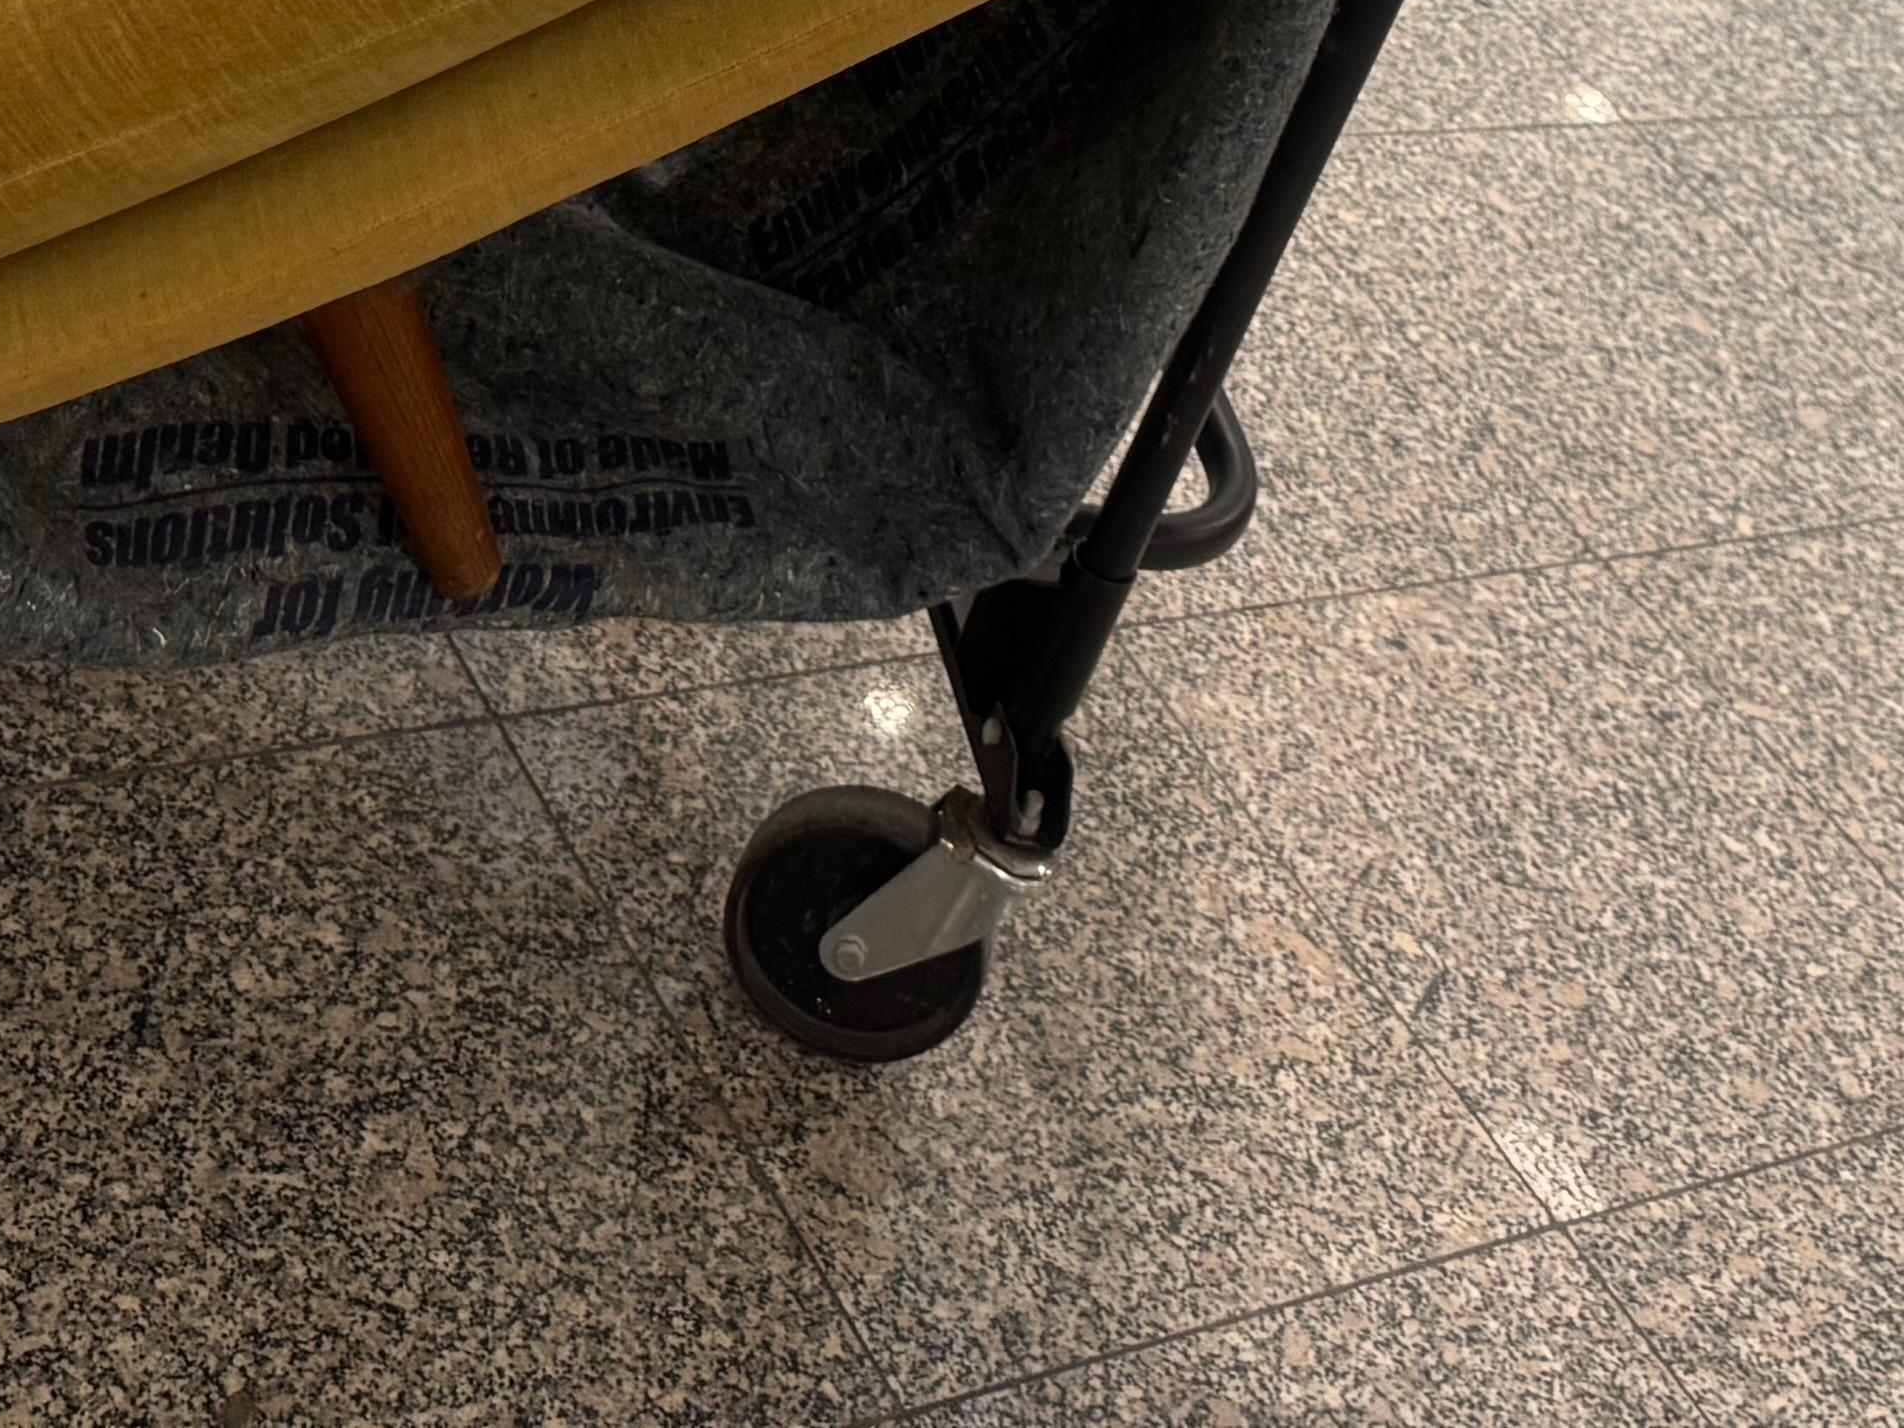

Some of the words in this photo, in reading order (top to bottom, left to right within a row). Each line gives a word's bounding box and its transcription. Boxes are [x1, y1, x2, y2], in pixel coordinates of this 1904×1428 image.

[79, 419, 274, 492] Denim
[284, 423, 529, 478] Reed
[535, 435, 586, 481] of
[596, 433, 731, 483] Made
[84, 492, 366, 571] Solutions
[378, 487, 756, 546] Environmel
[252, 575, 344, 640] for
